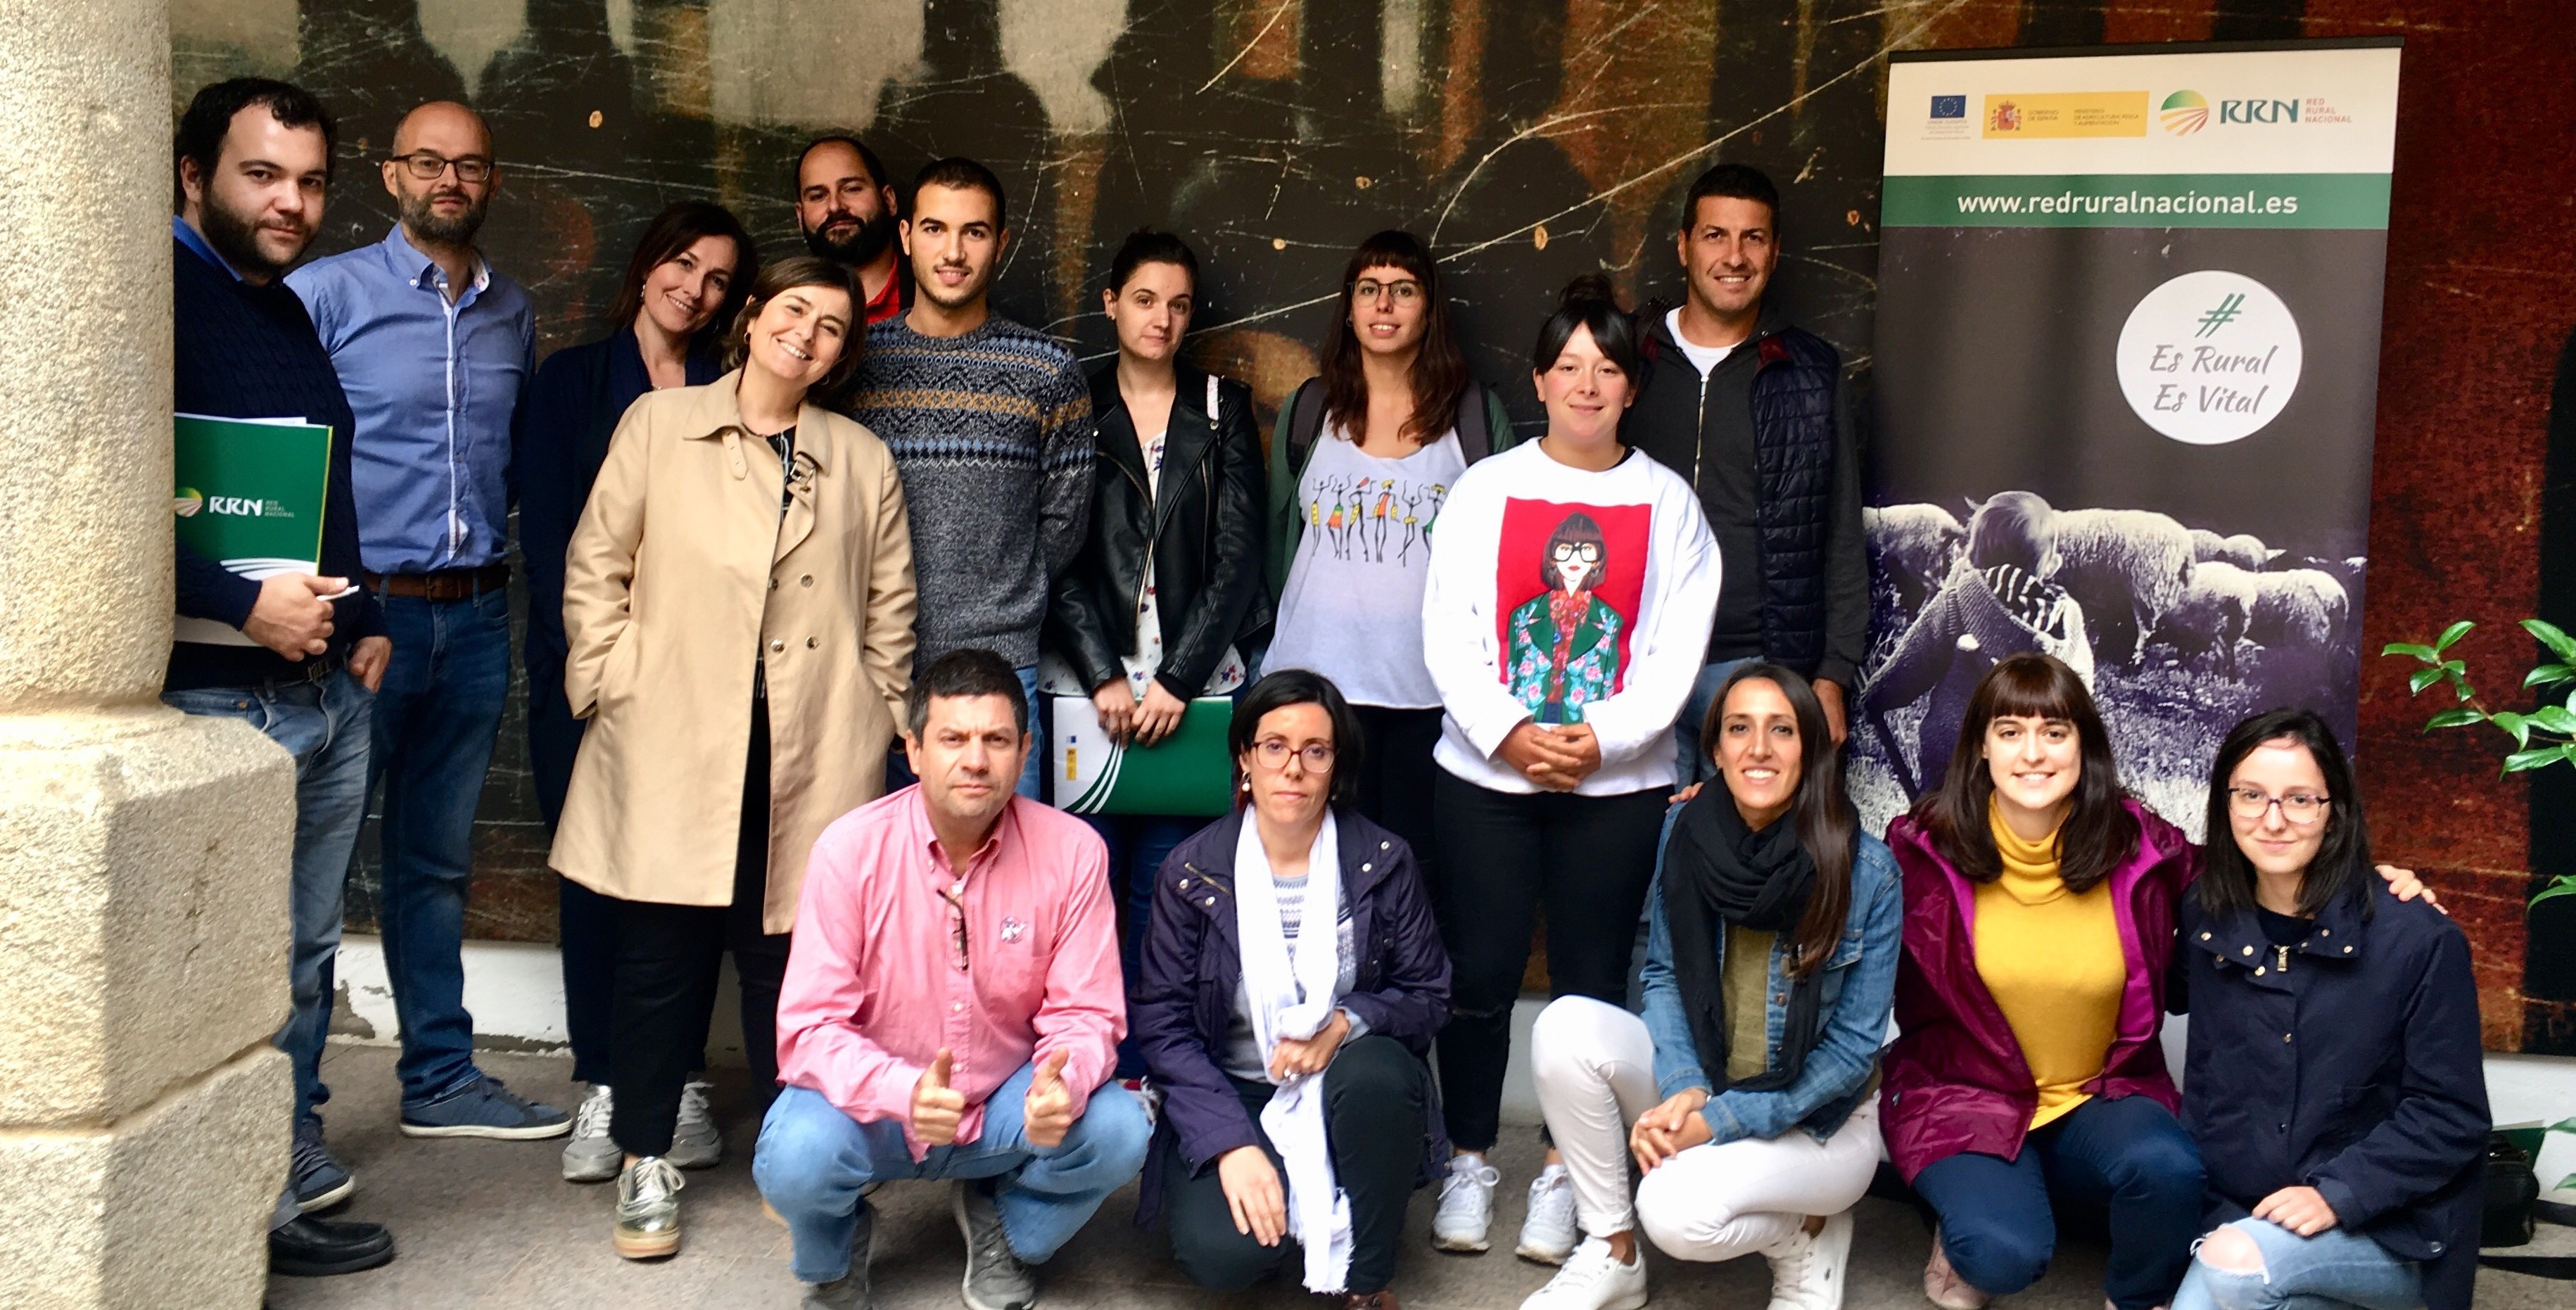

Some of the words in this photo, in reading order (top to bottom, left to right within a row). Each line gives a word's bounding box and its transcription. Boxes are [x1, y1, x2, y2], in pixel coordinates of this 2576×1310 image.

[2220, 98, 2299, 125] RRN
[2304, 106, 2337, 115] RURAL
[2305, 97, 2326, 106] RED
[2304, 115, 2353, 124] NACIONAL
[1957, 190, 2299, 214] www.redruralnacional.es
[2194, 292, 2246, 338] #
[2149, 344, 2184, 374] Es
[2190, 344, 2279, 375] Rural
[2153, 383, 2188, 413] Es
[2198, 384, 2269, 415] Vital
[209, 495, 263, 517] RRN
